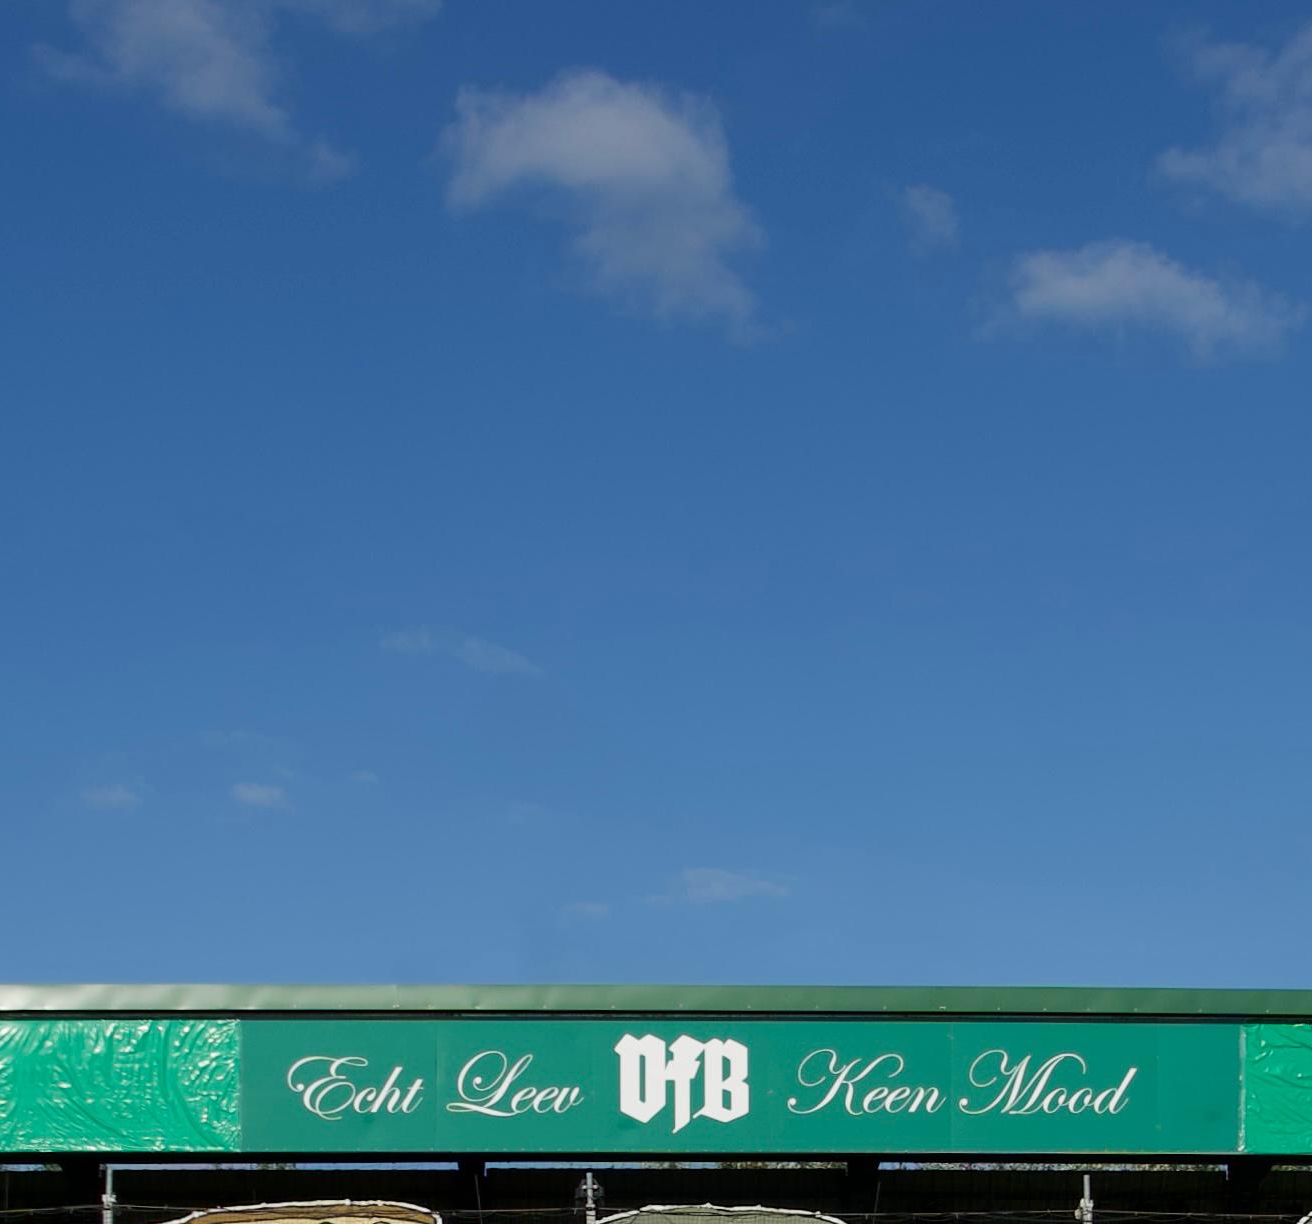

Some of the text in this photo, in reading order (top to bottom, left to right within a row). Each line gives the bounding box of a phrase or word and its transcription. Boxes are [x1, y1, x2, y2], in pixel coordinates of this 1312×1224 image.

[287, 1033, 1137, 1134] Echt Leev VfB Keen Mood
